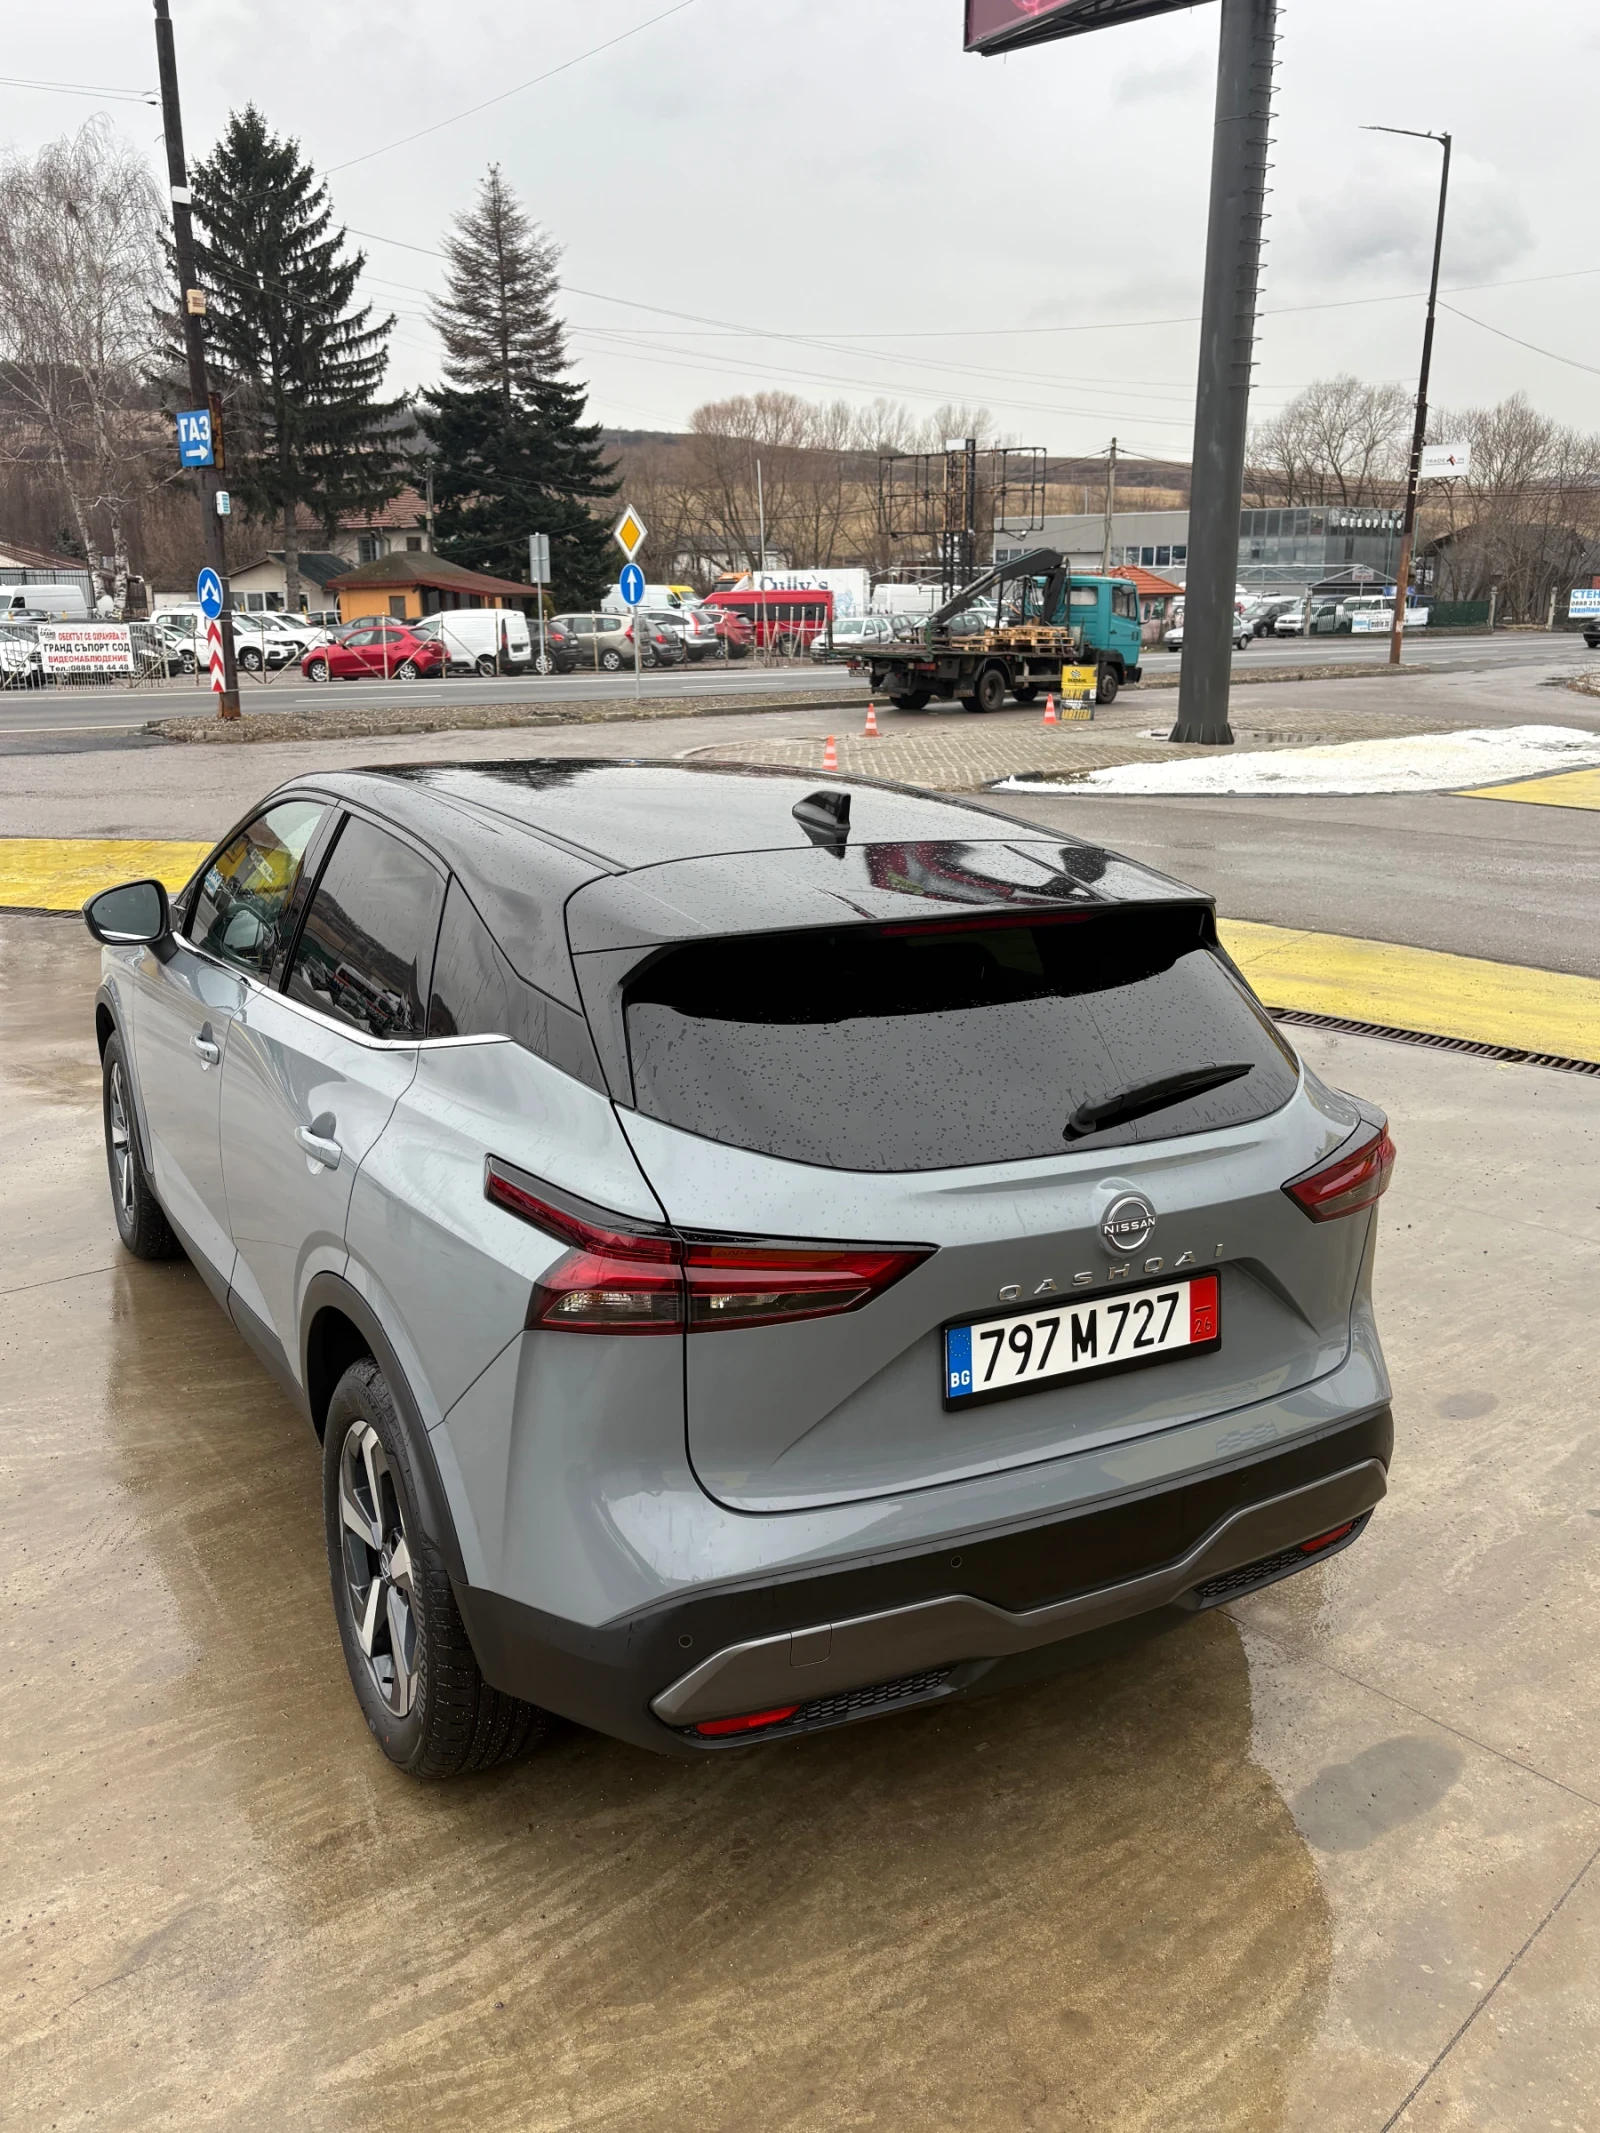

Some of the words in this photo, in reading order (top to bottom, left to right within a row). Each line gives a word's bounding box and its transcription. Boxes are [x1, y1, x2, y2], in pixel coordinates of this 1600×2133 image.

[180, 416, 208, 442] ГАЗ
[58, 632, 83, 641] ОБЕКТЪТ
[84, 632, 91, 640] СЕ
[92, 632, 119, 640] ОХРАНЯВА
[120, 632, 127, 640] ОТ
[44, 643, 72, 653] ГРАНД
[74, 643, 110, 652] СЪПОРТ
[112, 643, 130, 652] СОД
[48, 655, 128, 663] ВИДЕОНАБЛЮДЕНИЕ
[1103, 1216, 1156, 1235] NISSAN
[998, 1243, 1224, 1300] QASHQAI
[1194, 1317, 1212, 1334] 26
[980, 1316, 1061, 1382] 797
[1071, 1309, 1098, 1363] M
[1107, 1291, 1180, 1355] 727
[950, 1369, 971, 1388] BG
